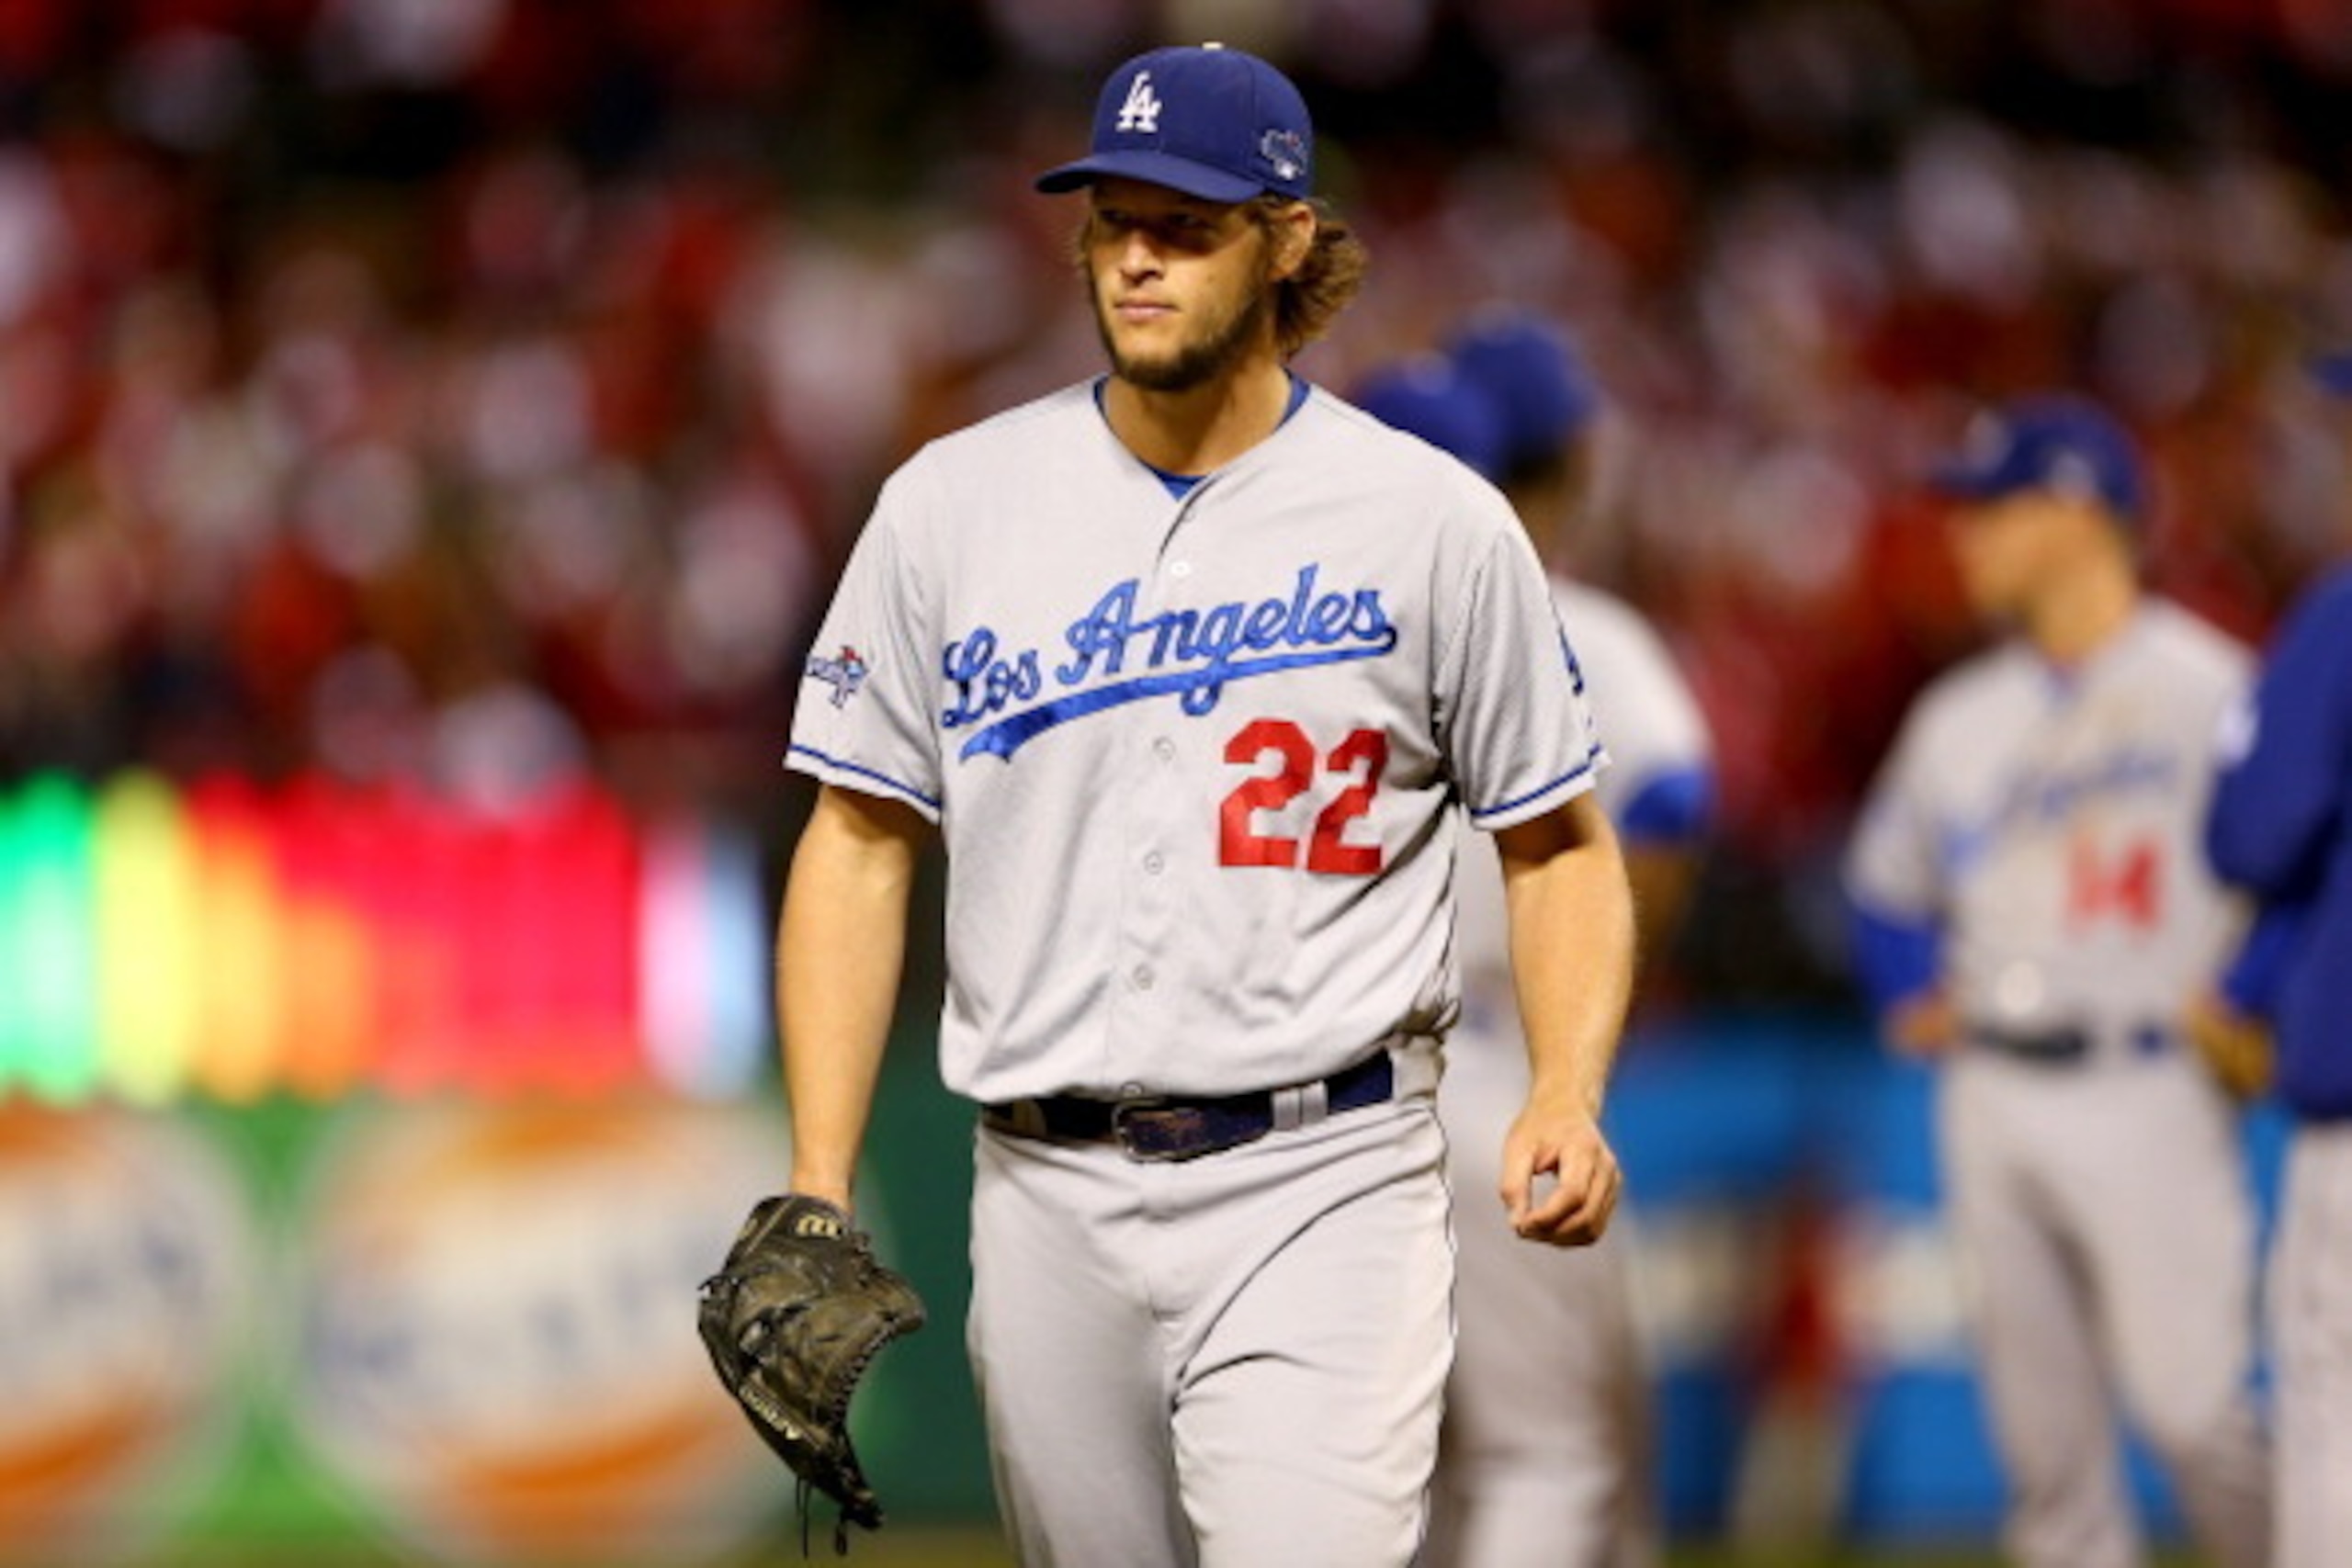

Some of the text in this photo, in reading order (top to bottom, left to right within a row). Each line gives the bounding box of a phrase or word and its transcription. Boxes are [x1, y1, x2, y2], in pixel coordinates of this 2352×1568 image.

[1115, 70, 1162, 132] LA
[941, 562, 1397, 729] Los Angeles
[1218, 716, 1389, 876] 22
